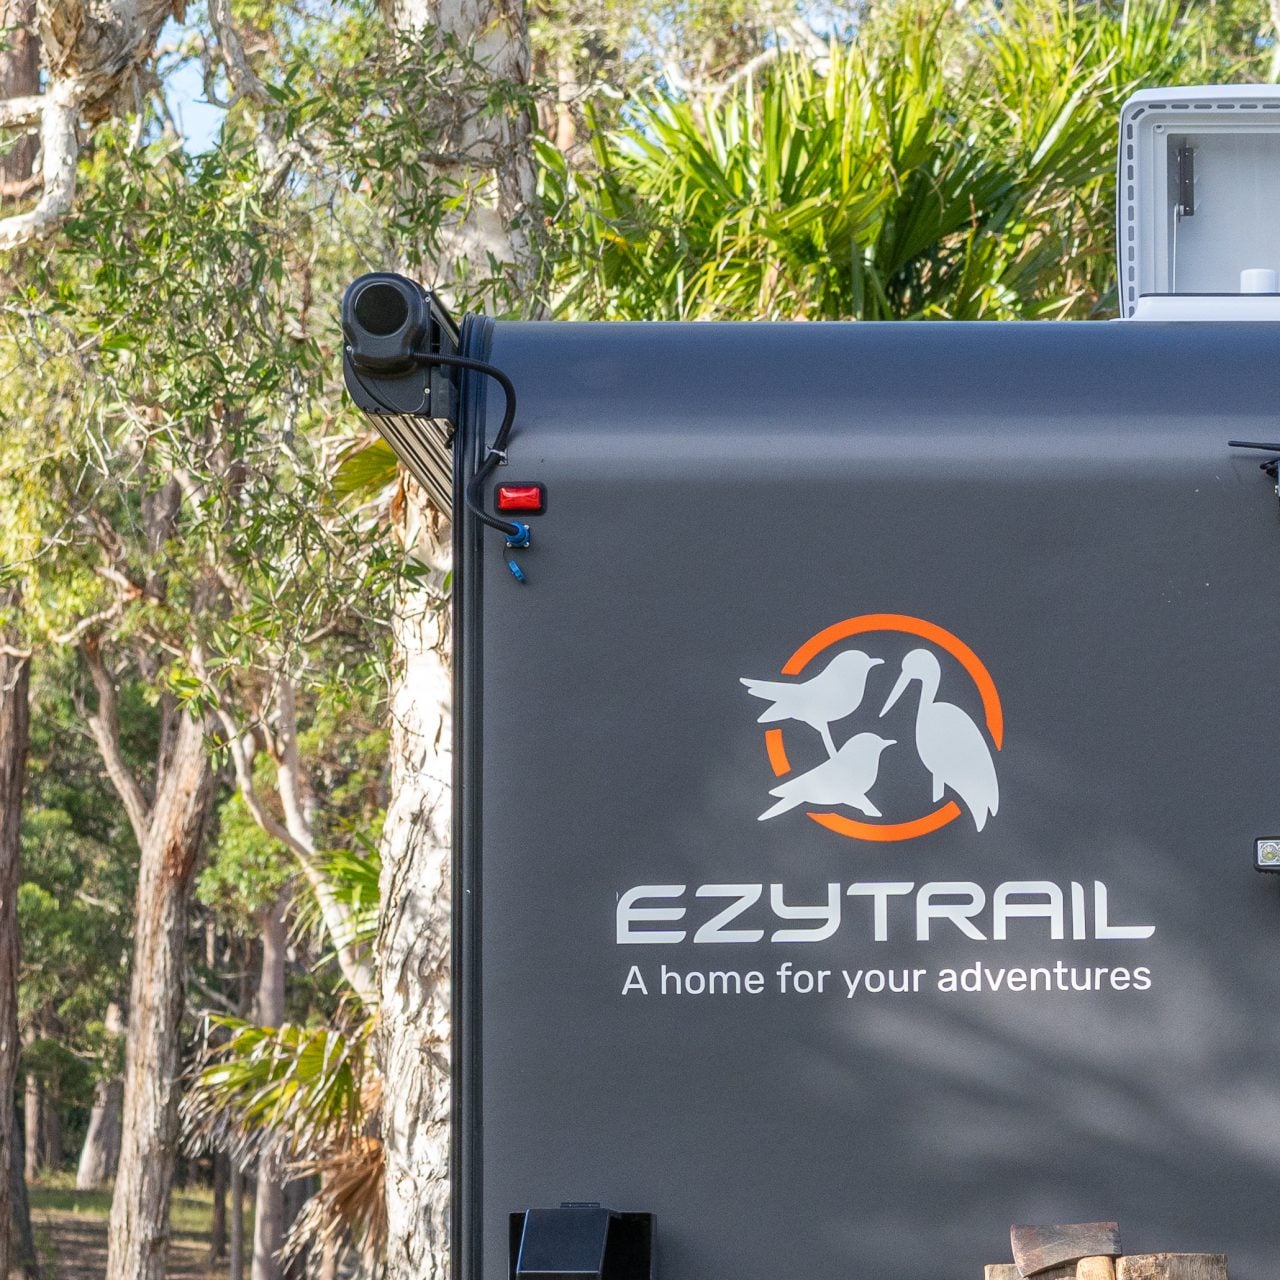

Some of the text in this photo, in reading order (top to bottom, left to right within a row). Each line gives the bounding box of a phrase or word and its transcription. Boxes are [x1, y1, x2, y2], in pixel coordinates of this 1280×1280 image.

[617, 881, 1156, 944] EZYTRAIL
[621, 960, 1152, 999] A home for your adventures
